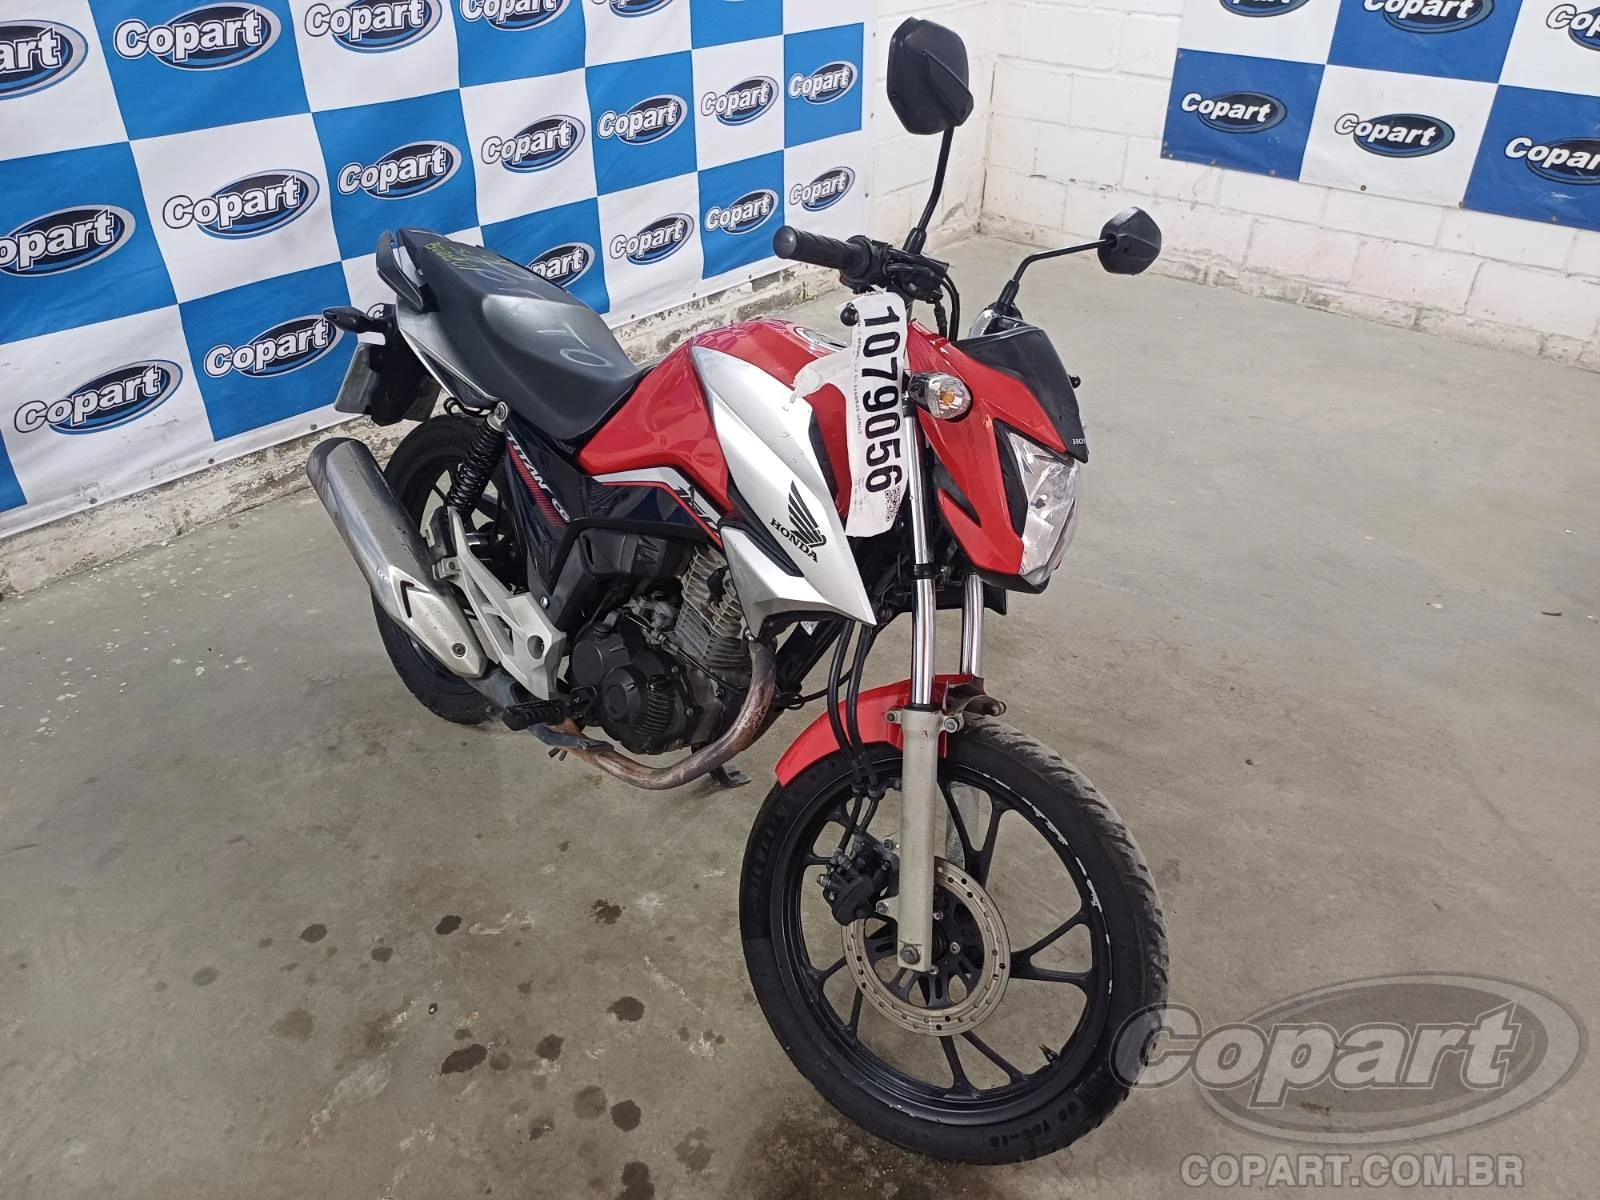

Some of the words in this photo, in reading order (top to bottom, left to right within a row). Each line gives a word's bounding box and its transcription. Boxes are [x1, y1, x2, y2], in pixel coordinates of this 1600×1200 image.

[114, 9, 264, 62] Copart
[305, 0, 425, 41] Copart
[1546, 3, 1600, 37] Cop
[0, 26, 61, 74] art
[701, 80, 771, 117] Copart
[788, 65, 850, 100] Copart
[597, 97, 680, 142] Copart
[1181, 92, 1272, 124] Copart
[1334, 113, 1440, 147] Copart
[481, 121, 573, 165] Copart
[1504, 136, 1600, 170] Copar
[338, 145, 448, 196] Copart
[789, 171, 848, 208] Copart
[163, 175, 302, 230] Copart
[704, 193, 771, 233] Copart
[0, 208, 115, 271] opart
[609, 217, 686, 261] Copart
[531, 246, 584, 279] part
[205, 317, 329, 379] Copart
[14, 365, 162, 433] Copart
[862, 306, 903, 493] 1079056
[770, 517, 818, 563] HONDA
